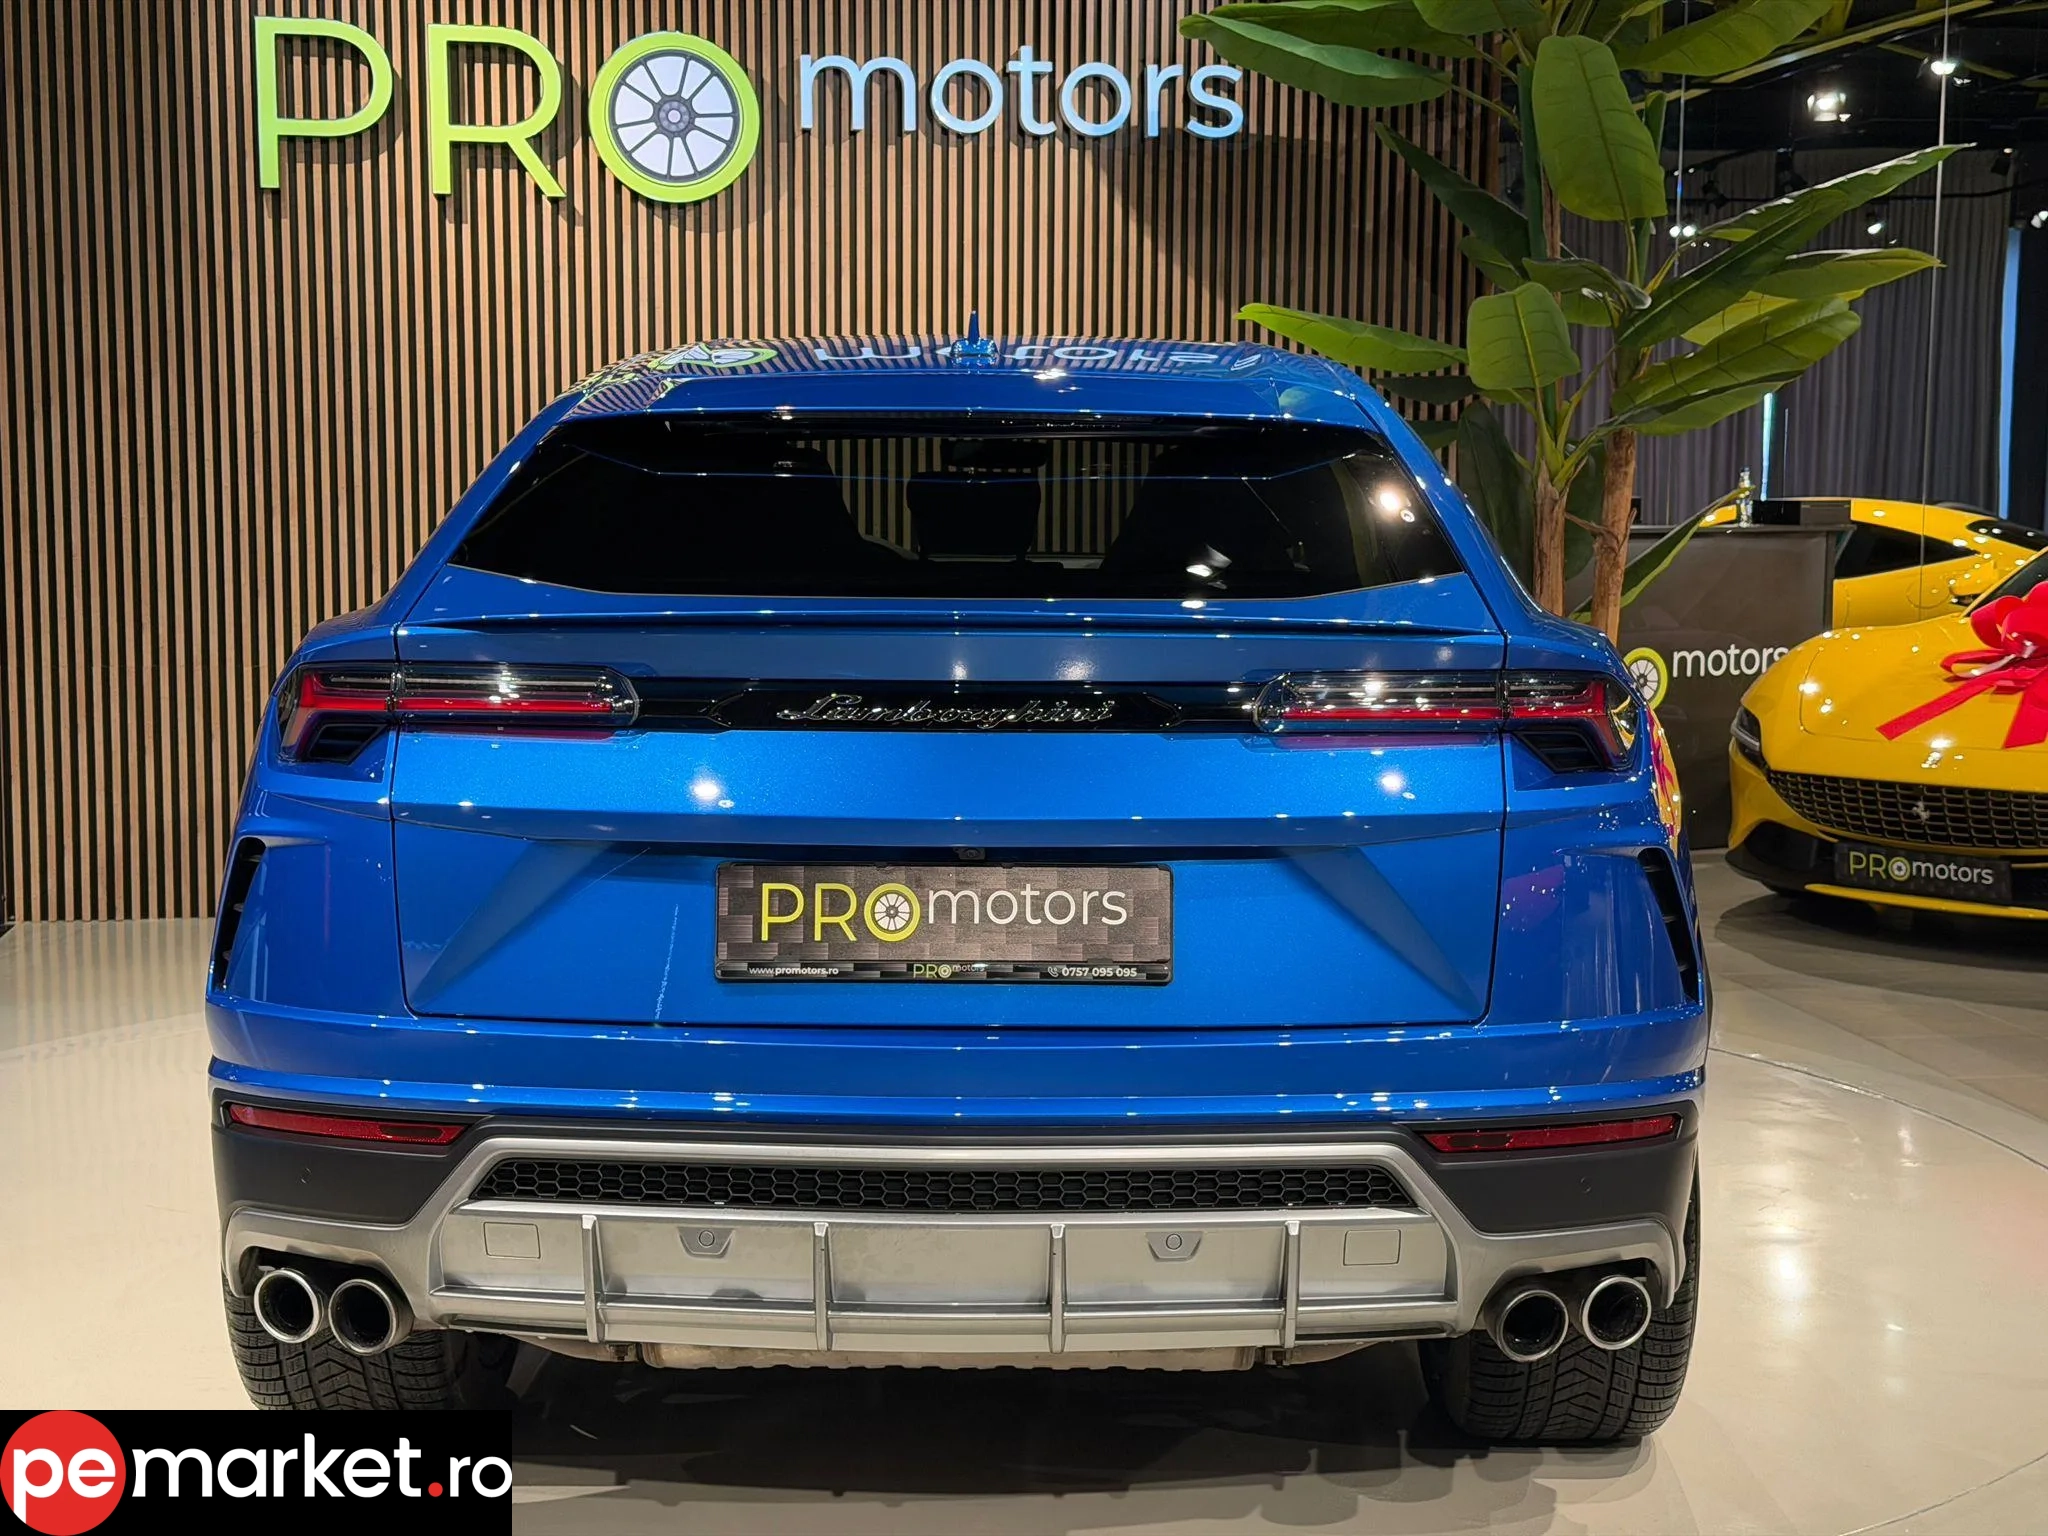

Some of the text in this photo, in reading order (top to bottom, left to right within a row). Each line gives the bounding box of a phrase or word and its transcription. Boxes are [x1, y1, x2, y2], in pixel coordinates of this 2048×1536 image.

[776, 694, 1116, 729] Lamborghini
[749, 966, 839, 976] www.promotors.ro
[1061, 967, 1138, 977] 0757 095 095
